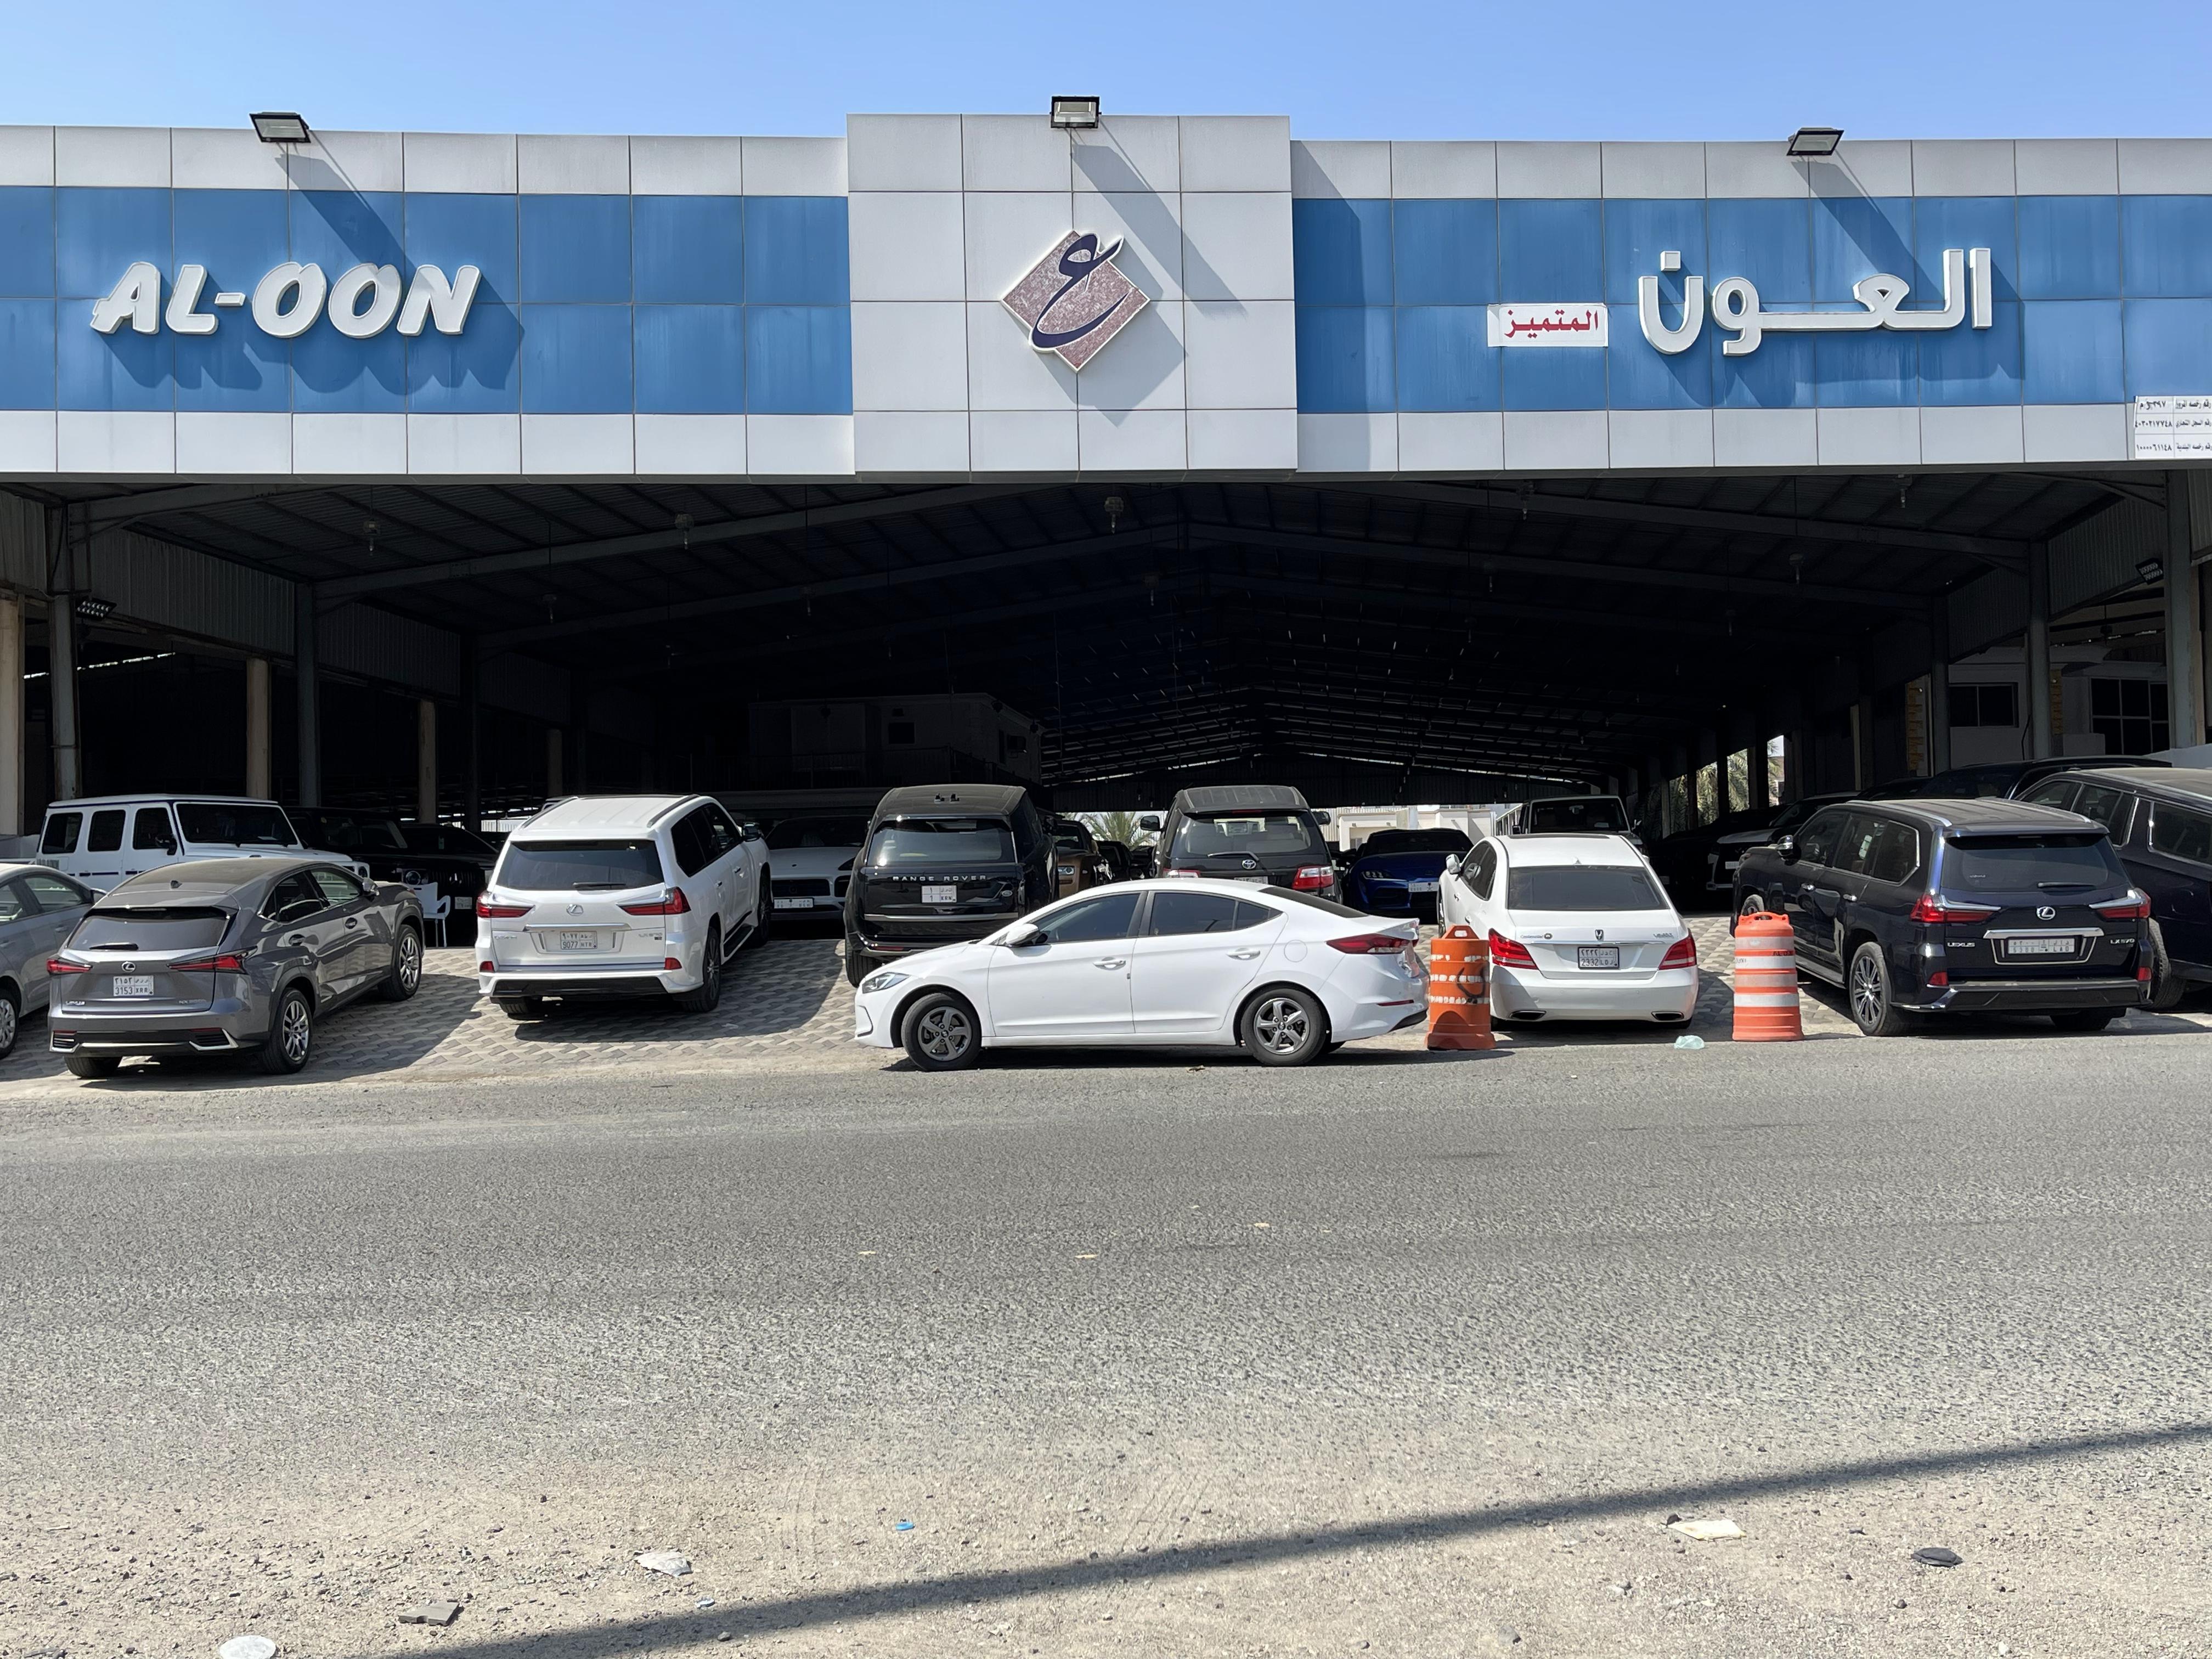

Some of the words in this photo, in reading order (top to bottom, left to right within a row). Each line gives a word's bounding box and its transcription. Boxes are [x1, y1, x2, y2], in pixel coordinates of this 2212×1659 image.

[90, 261, 481, 338] AL-OON
[1504, 309, 1598, 338] المتميز
[1638, 247, 1993, 356] العون
